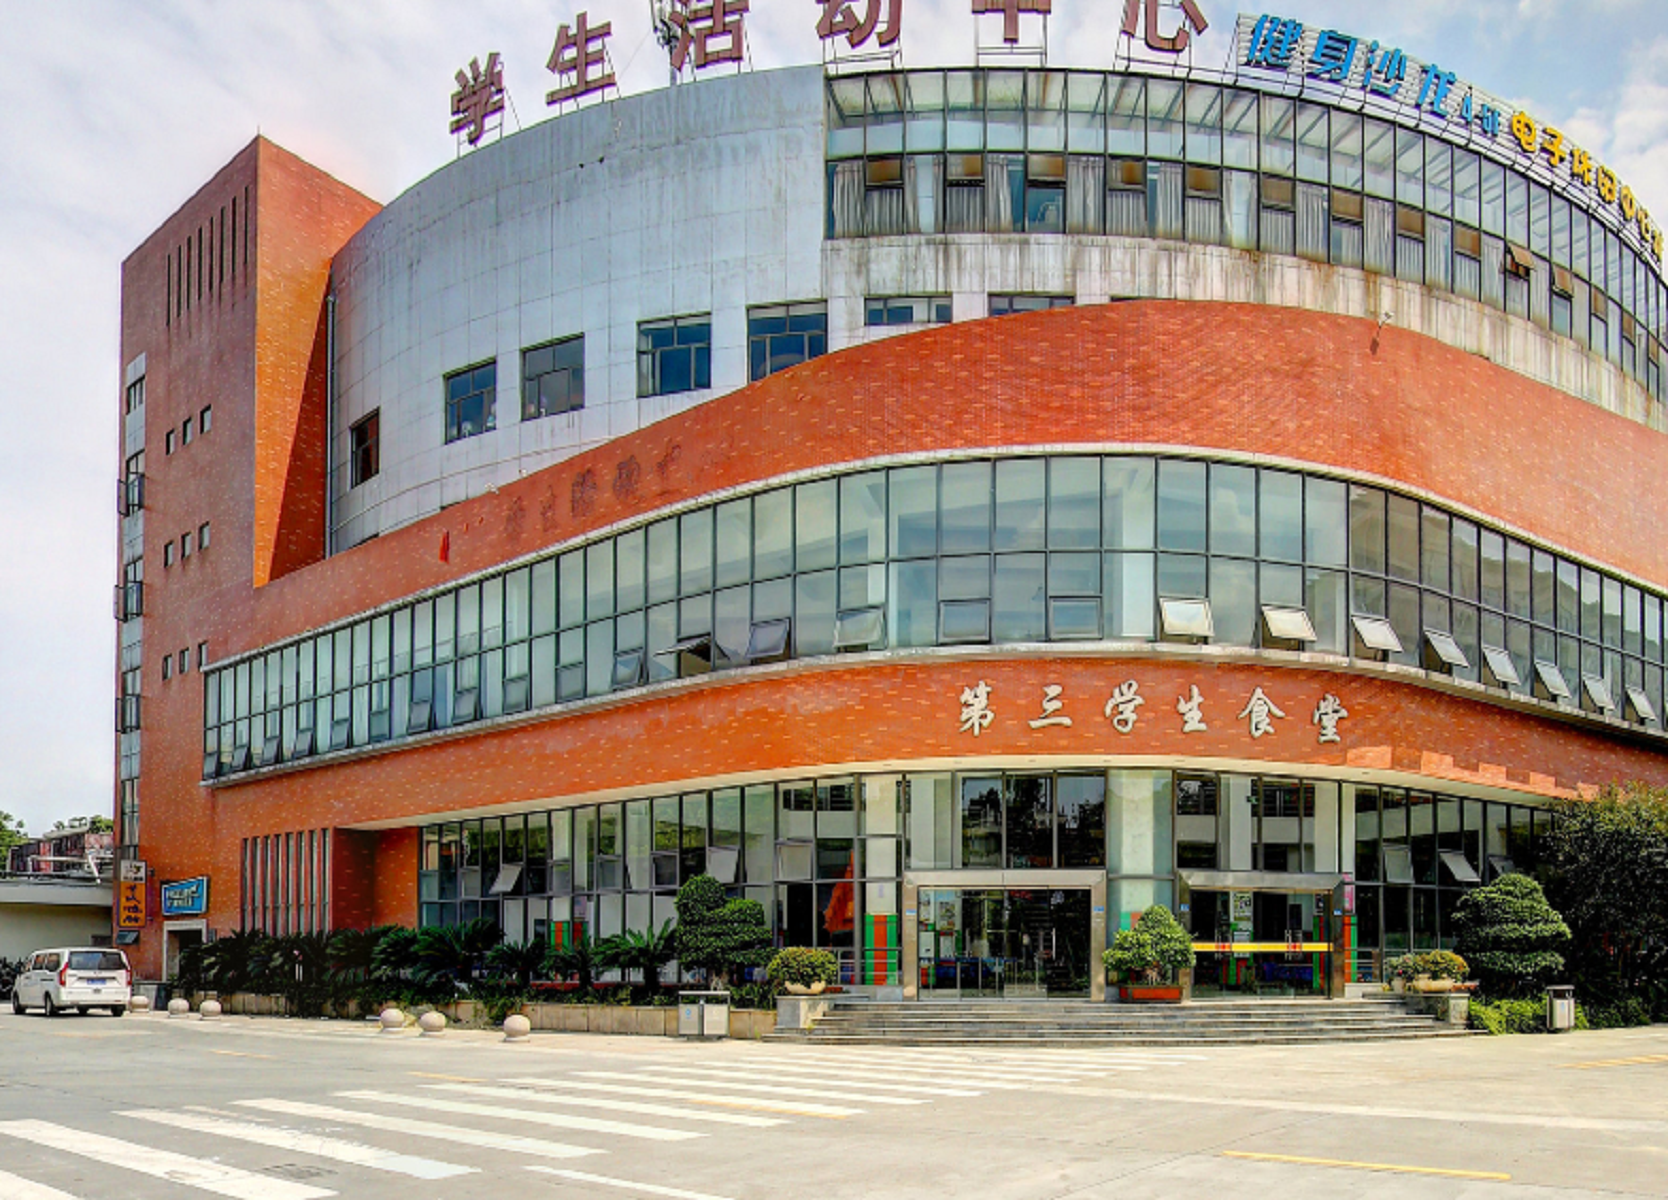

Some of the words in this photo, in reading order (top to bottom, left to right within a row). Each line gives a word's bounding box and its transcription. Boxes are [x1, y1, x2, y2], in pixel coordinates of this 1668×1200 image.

[959, 680, 1348, 744] 第三学生食堂
